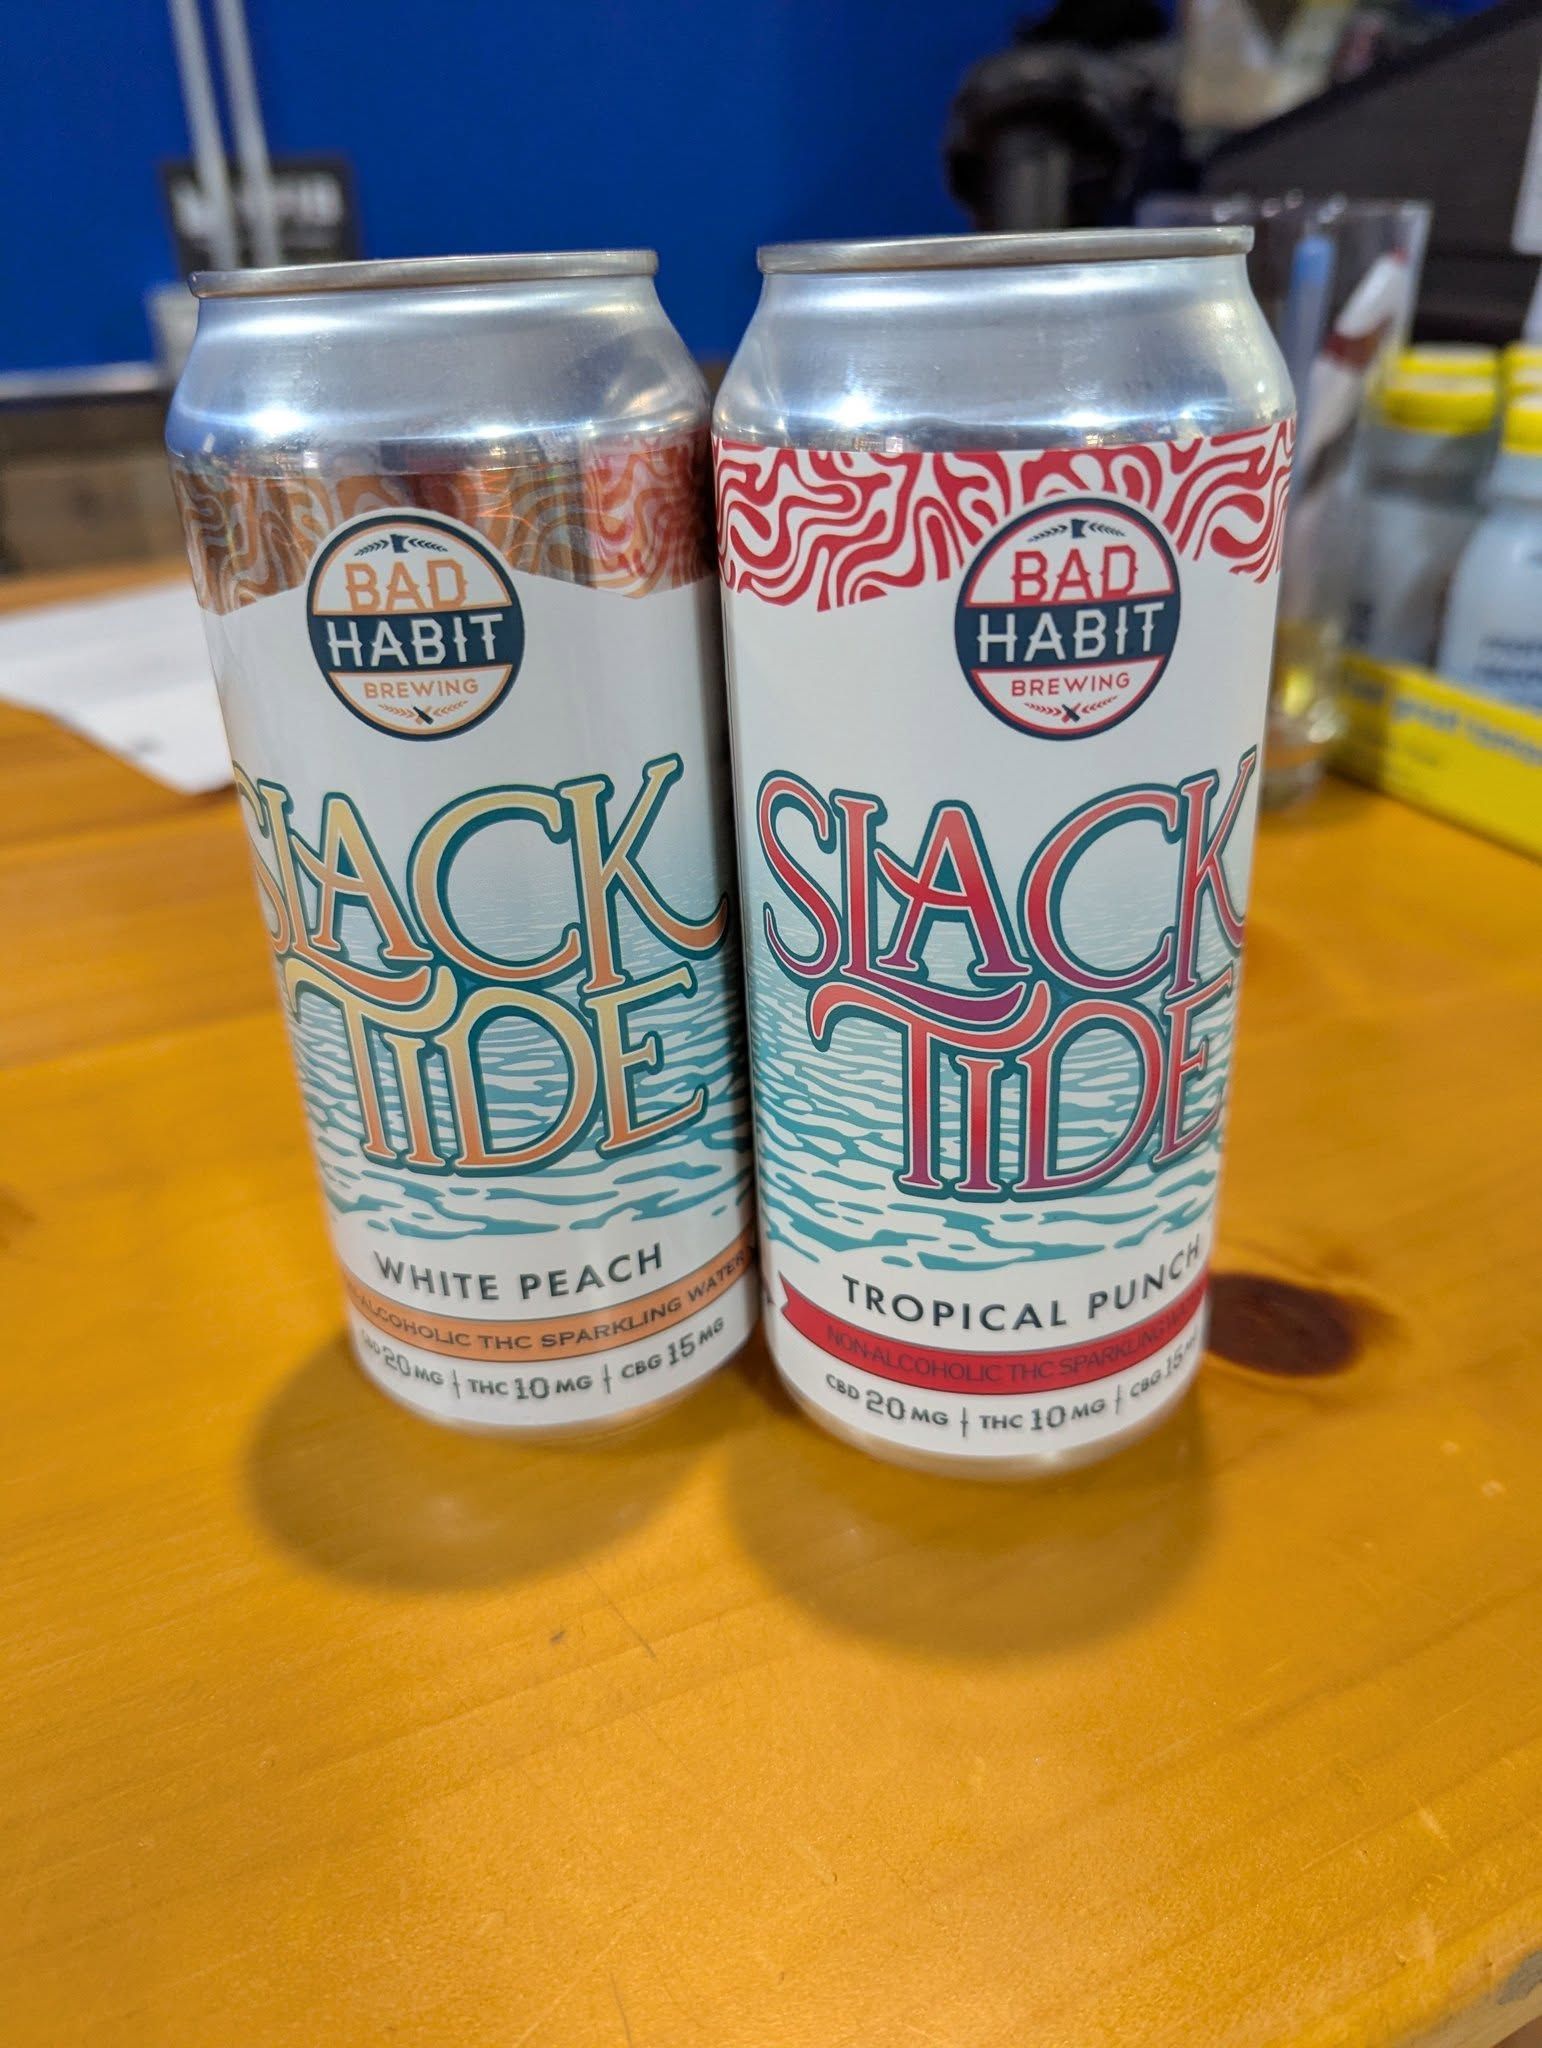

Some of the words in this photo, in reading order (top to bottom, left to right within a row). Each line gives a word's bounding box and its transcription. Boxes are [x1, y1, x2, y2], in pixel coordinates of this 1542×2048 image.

[344, 557, 468, 611] BAD
[1011, 545, 1138, 602] BAD
[326, 613, 504, 667] HABIT
[976, 602, 1165, 663] HABIT
[363, 678, 479, 699] BREWING
[1011, 672, 1131, 697] BREWING
[757, 745, 1257, 1026] SLACK
[284, 960, 709, 1176] TIDE
[806, 961, 1236, 1202] TIDE
[373, 1251, 500, 1301] WHITE
[520, 1242, 662, 1300] PEACH
[477, 1335, 532, 1349] THC
[541, 1296, 681, 1348] SPARKLING
[687, 1250, 745, 1302] WATER
[842, 1274, 1067, 1331] TROPICAL
[1088, 1233, 1200, 1319] PUNCH
[382, 1345, 411, 1376] 20
[415, 1365, 444, 1385] MG
[467, 1378, 508, 1395] THC
[514, 1376, 550, 1400] 10
[556, 1375, 593, 1393] MG
[621, 1353, 662, 1379] CBG
[667, 1332, 696, 1365] 15
[699, 1317, 725, 1344] MG
[1006, 1361, 1054, 1383] THC
[826, 1373, 860, 1400] CBD
[865, 1389, 906, 1420] 20
[910, 1405, 949, 1426] MG
[979, 1414, 1023, 1429] THC
[1030, 1405, 1066, 1431] 10
[1071, 1398, 1106, 1420] MG
[1130, 1369, 1161, 1397] CBG
